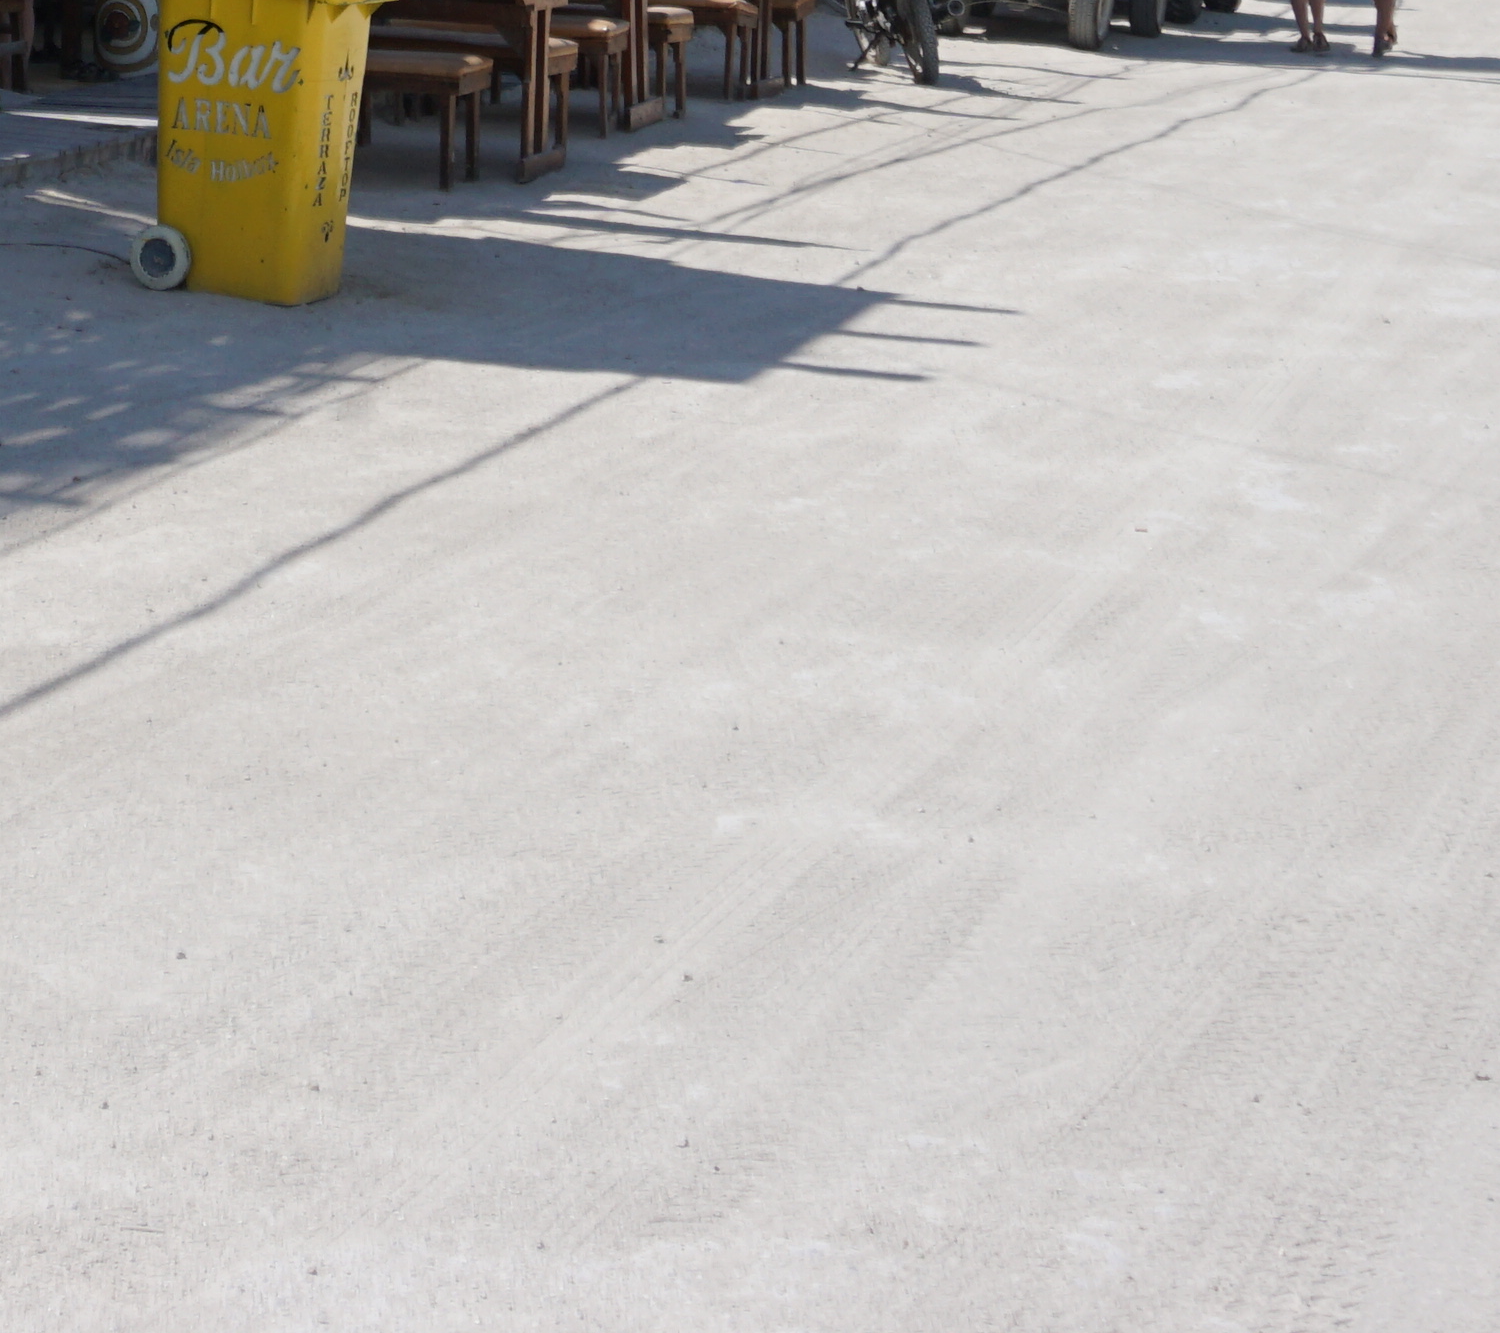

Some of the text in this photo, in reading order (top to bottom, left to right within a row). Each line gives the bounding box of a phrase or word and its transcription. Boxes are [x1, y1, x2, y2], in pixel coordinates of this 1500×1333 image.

[165, 19, 302, 93] Bar
[171, 97, 272, 140] ARENA
[312, 94, 334, 208] TERRAZA
[337, 92, 358, 202] ROOFTOP
[164, 140, 200, 174] Isla
